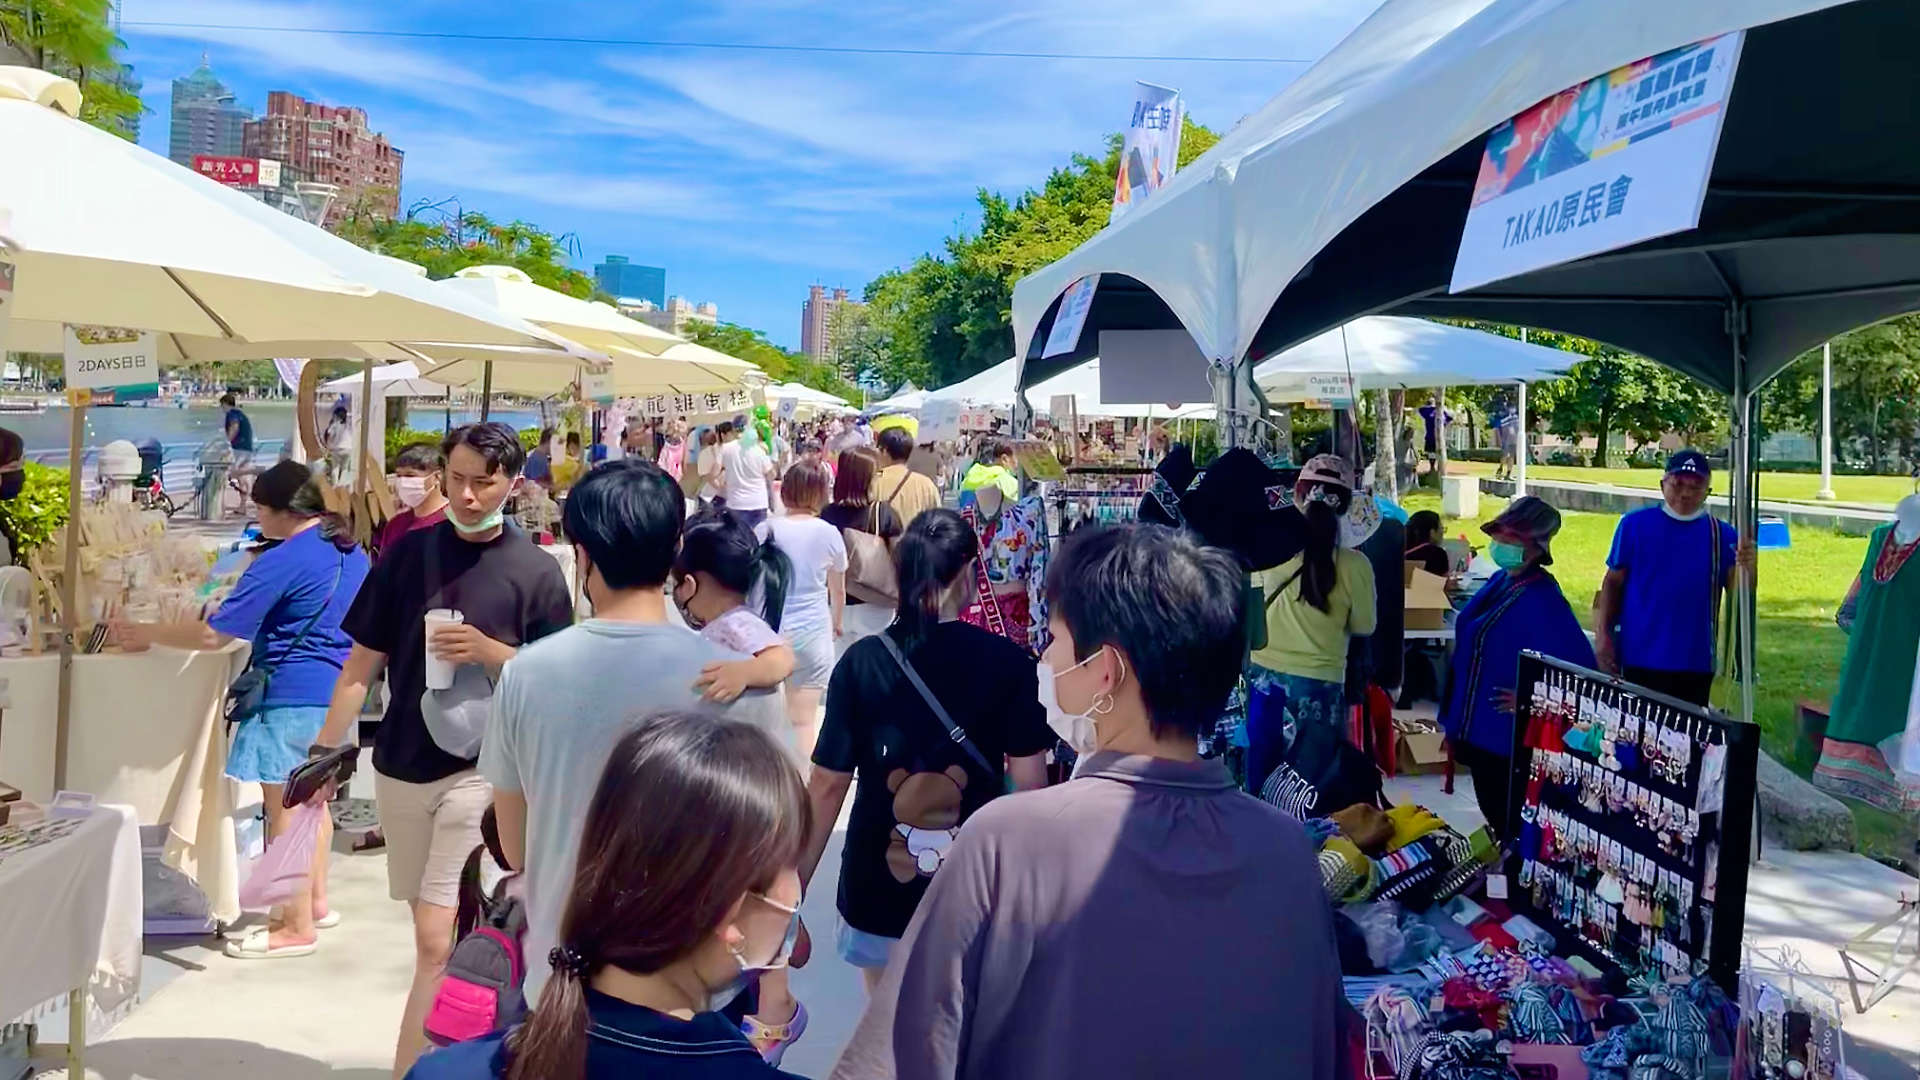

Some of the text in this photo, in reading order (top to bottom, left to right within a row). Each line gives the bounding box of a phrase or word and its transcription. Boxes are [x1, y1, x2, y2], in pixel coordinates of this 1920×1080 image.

[1503, 174, 1633, 249] TAKAO原民會
[78, 355, 146, 372] 2DAYS日日
